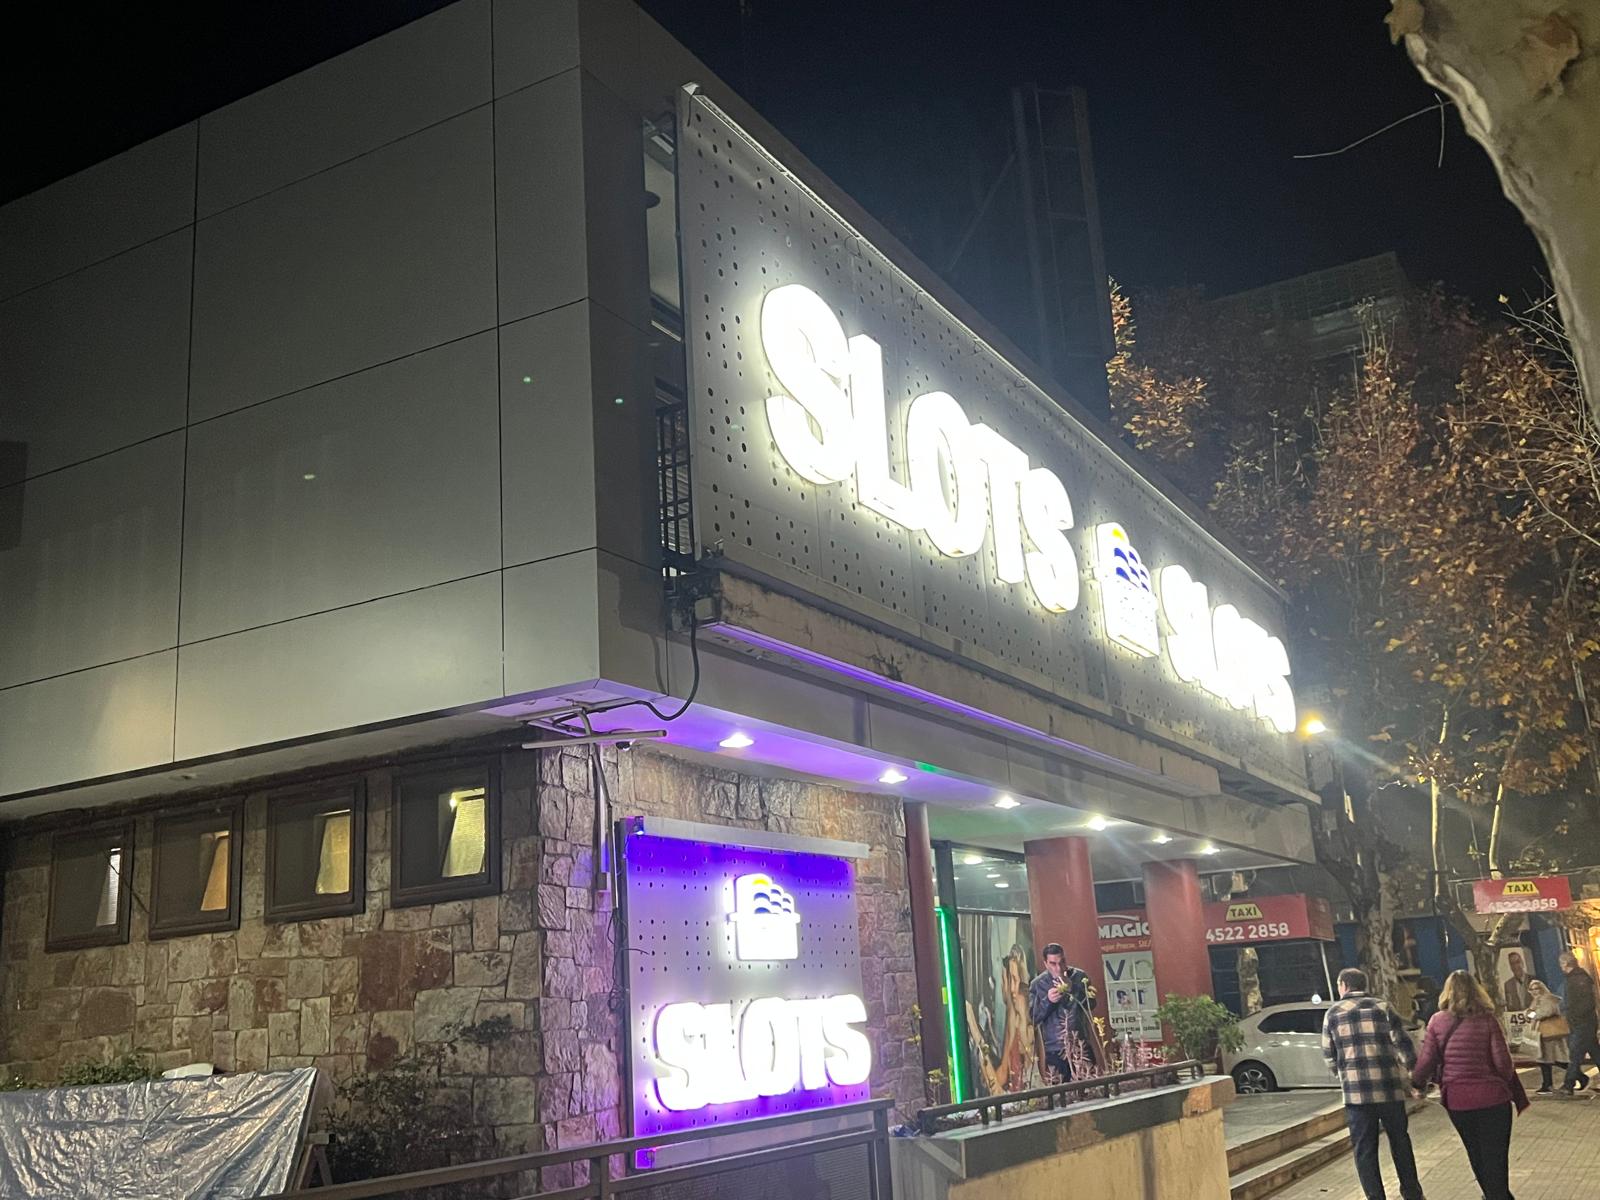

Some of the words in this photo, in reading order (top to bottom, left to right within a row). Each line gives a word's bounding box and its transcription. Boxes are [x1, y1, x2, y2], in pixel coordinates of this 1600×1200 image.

[760, 283, 1080, 613] SLOTS
[1507, 884, 1534, 893] TAXI
[1230, 907, 1257, 917] TAXI
[1206, 926, 1245, 942] 4522
[1248, 922, 1289, 939] 2858
[655, 994, 872, 1111] SLOTS
